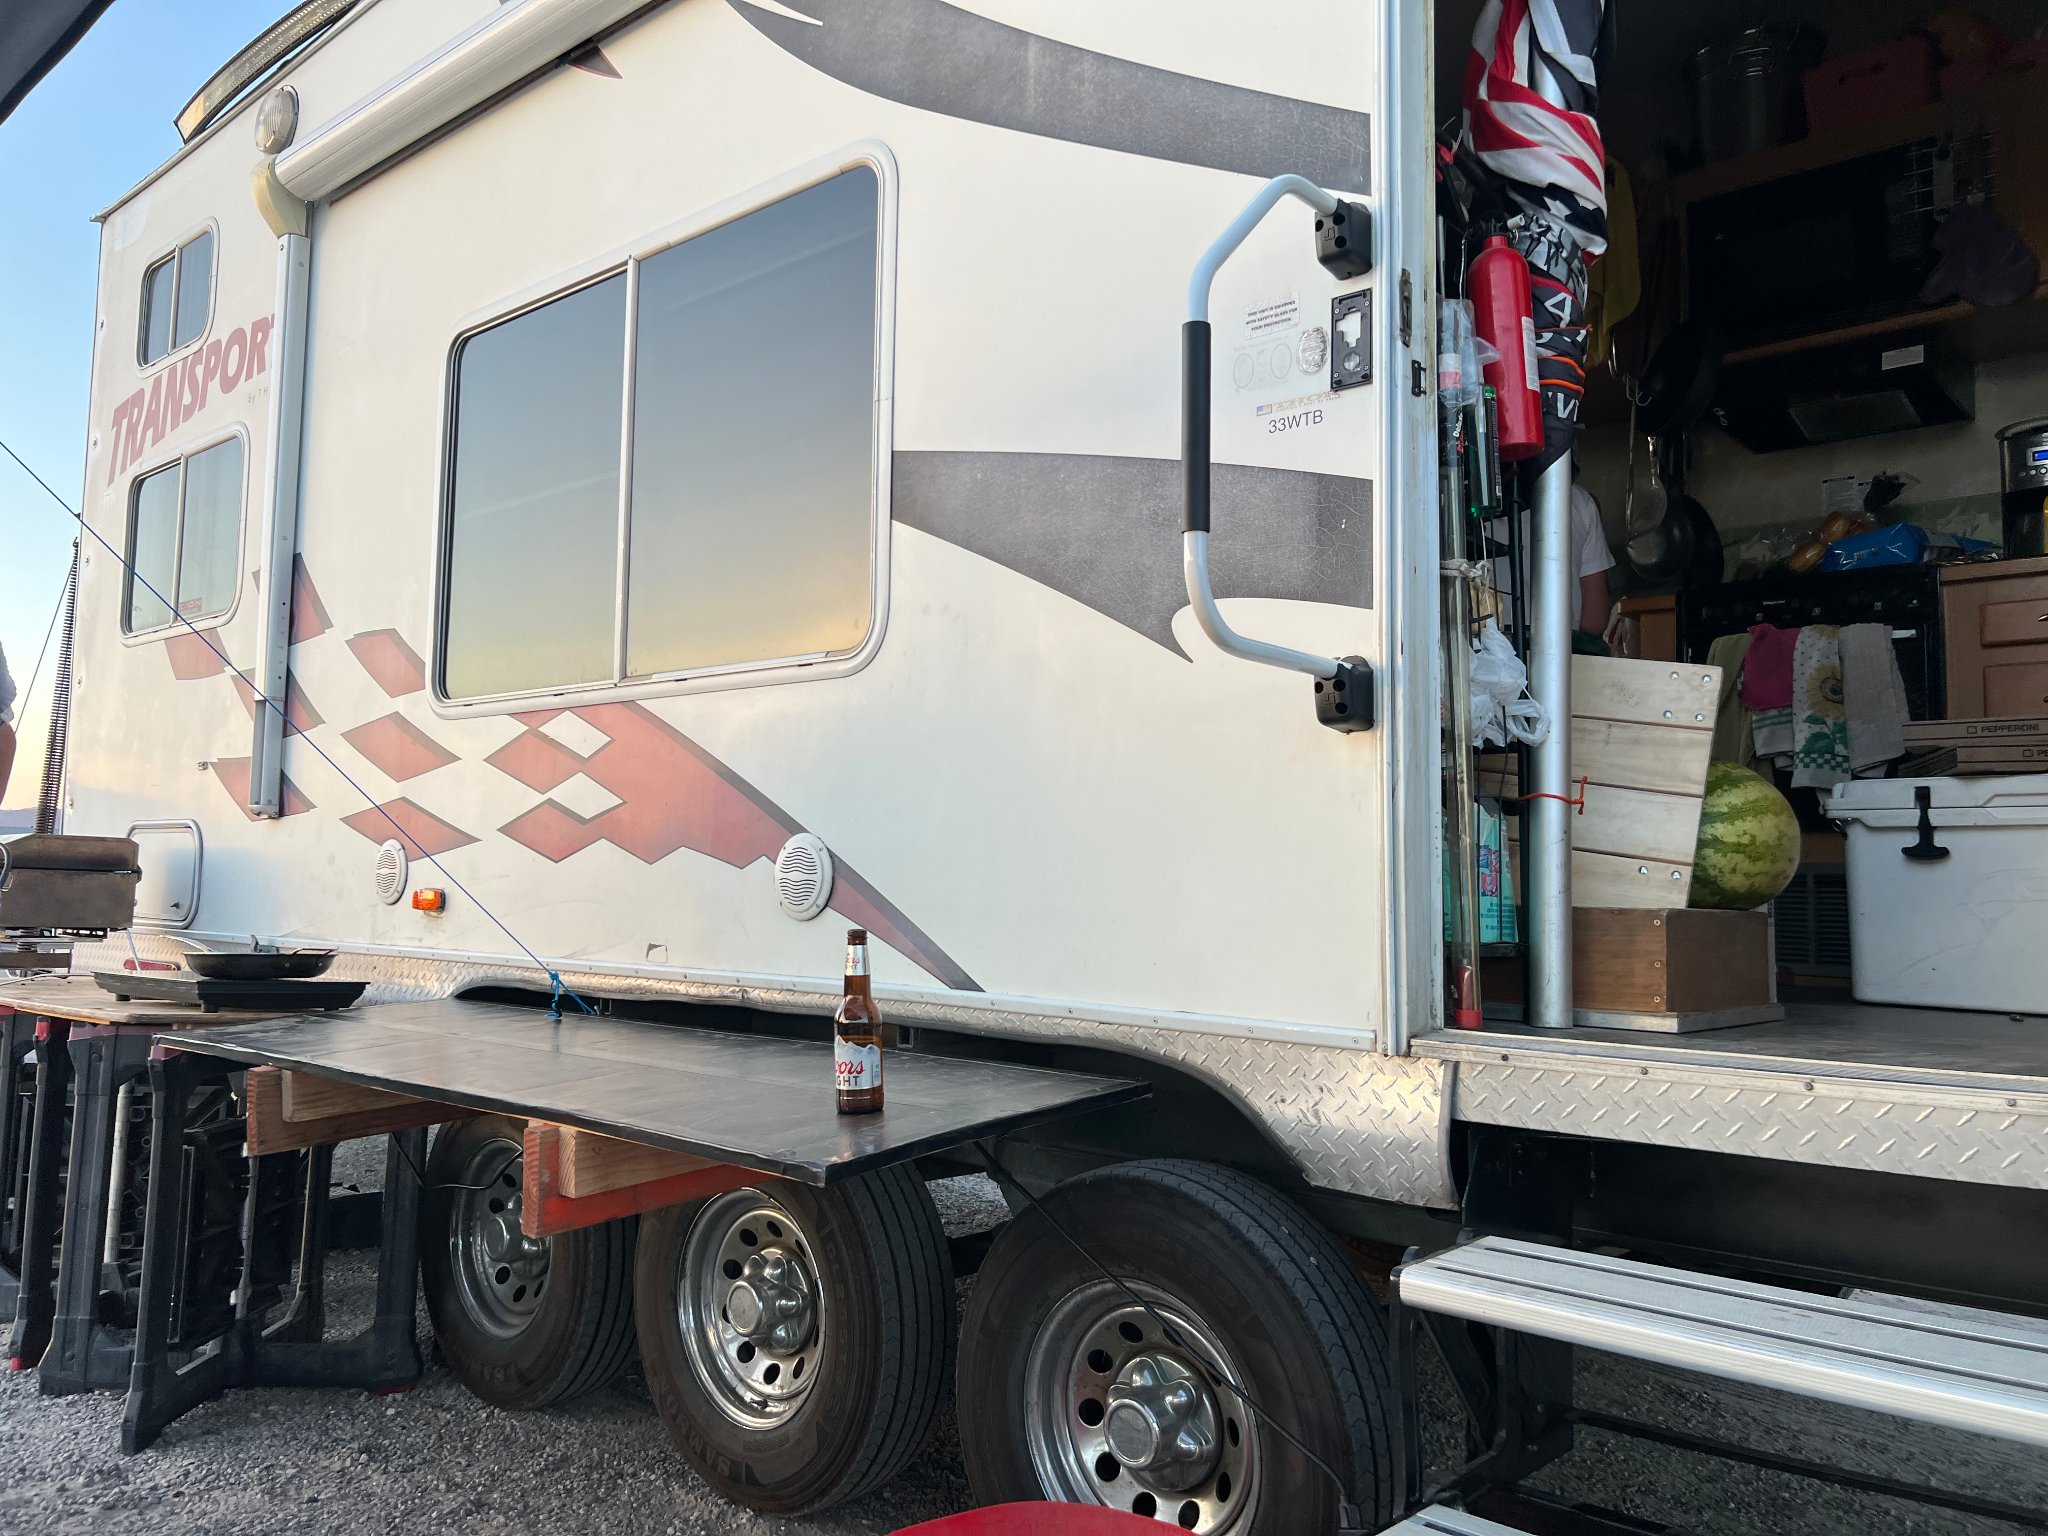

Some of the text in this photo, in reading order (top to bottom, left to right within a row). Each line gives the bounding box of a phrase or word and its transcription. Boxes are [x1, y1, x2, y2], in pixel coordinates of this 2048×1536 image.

[107, 313, 275, 488] TRANSPOR
[1268, 409, 1324, 434] 33WTB
[1981, 723, 2040, 733] PEPPERONI
